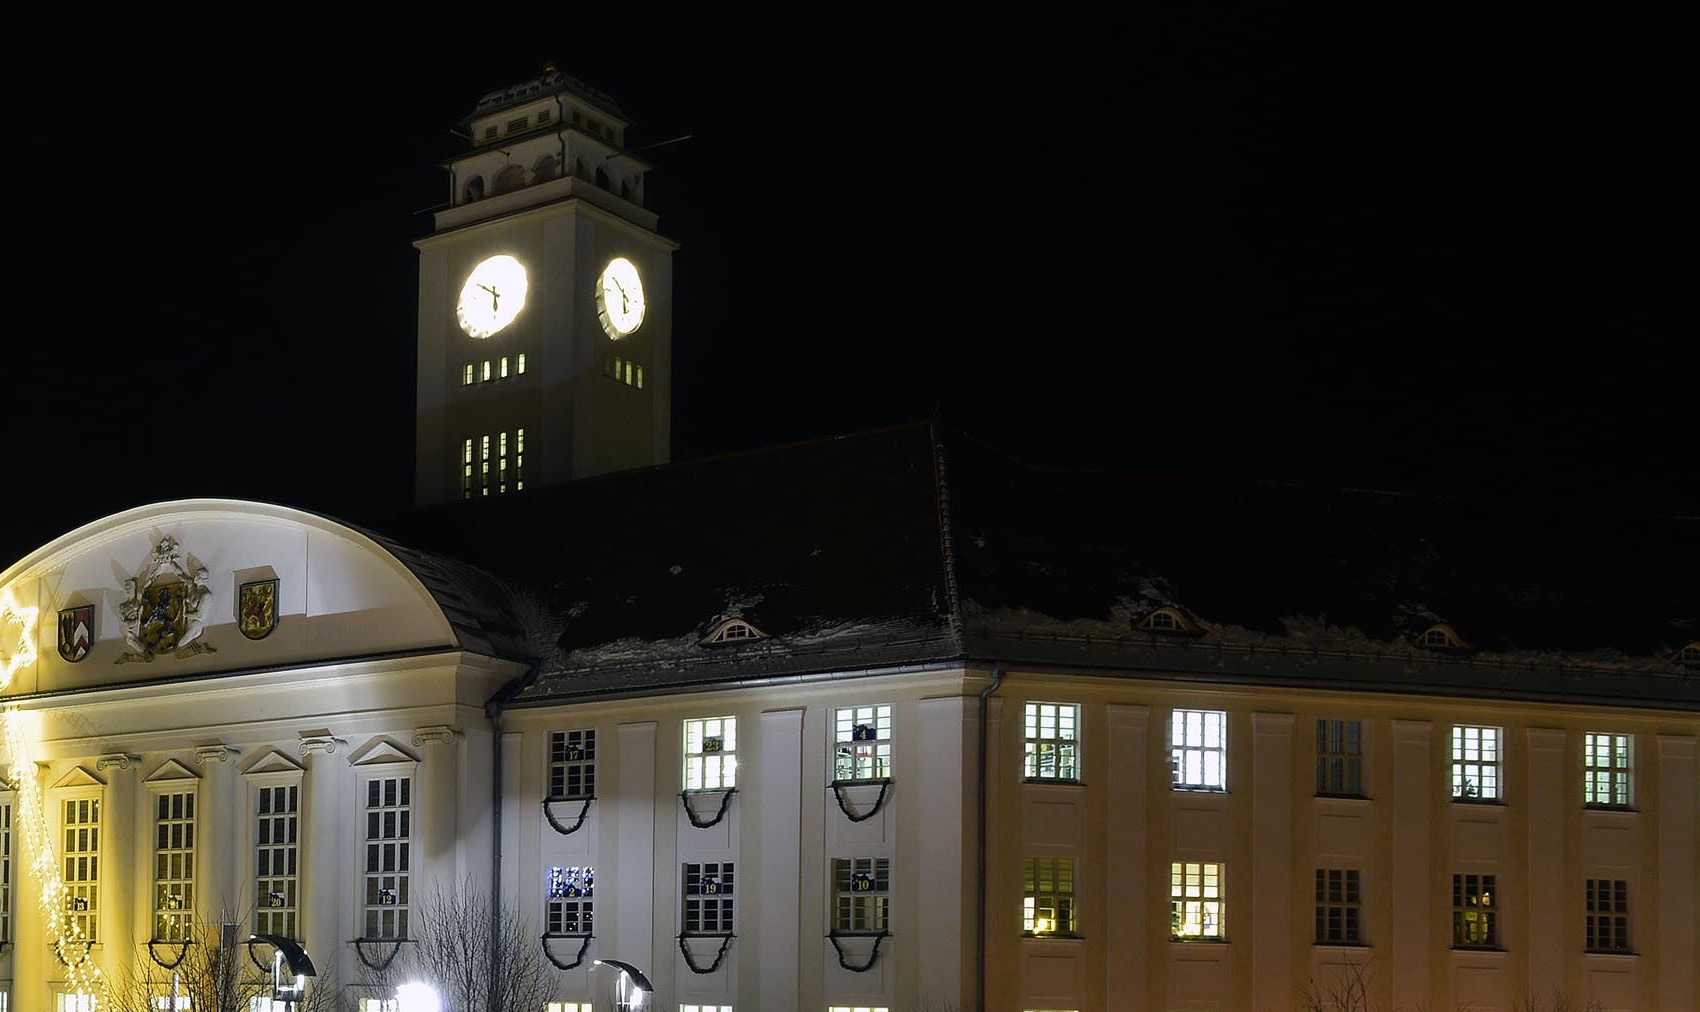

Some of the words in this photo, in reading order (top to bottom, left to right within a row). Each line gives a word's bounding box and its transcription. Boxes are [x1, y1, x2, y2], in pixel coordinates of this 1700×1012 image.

[859, 729, 867, 740] 4
[706, 741, 719, 751] 23
[569, 750, 579, 760] 17
[705, 884, 717, 893] 19
[858, 880, 869, 890] 10
[568, 888, 575, 897] 2
[271, 898, 281, 907] 20
[382, 895, 392, 904] 12
[77, 902, 84, 911] 13
